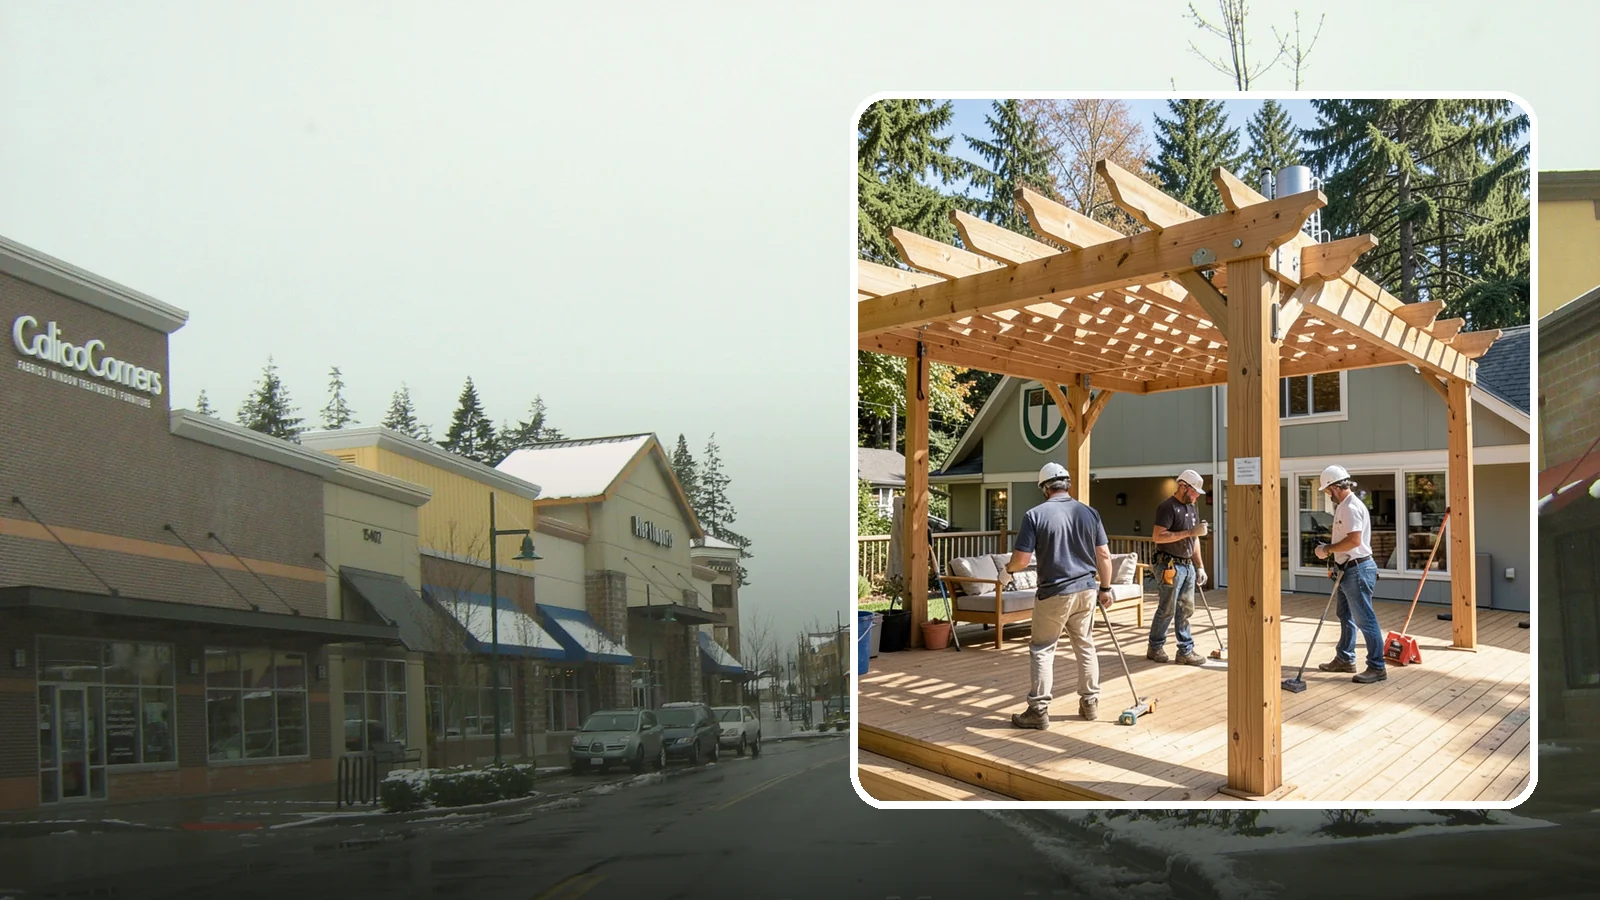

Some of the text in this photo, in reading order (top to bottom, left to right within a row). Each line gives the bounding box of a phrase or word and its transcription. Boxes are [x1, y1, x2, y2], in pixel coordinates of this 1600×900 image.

[16, 360, 151, 409] FABRICS WINDOW TREATMENTS FURNITURE
